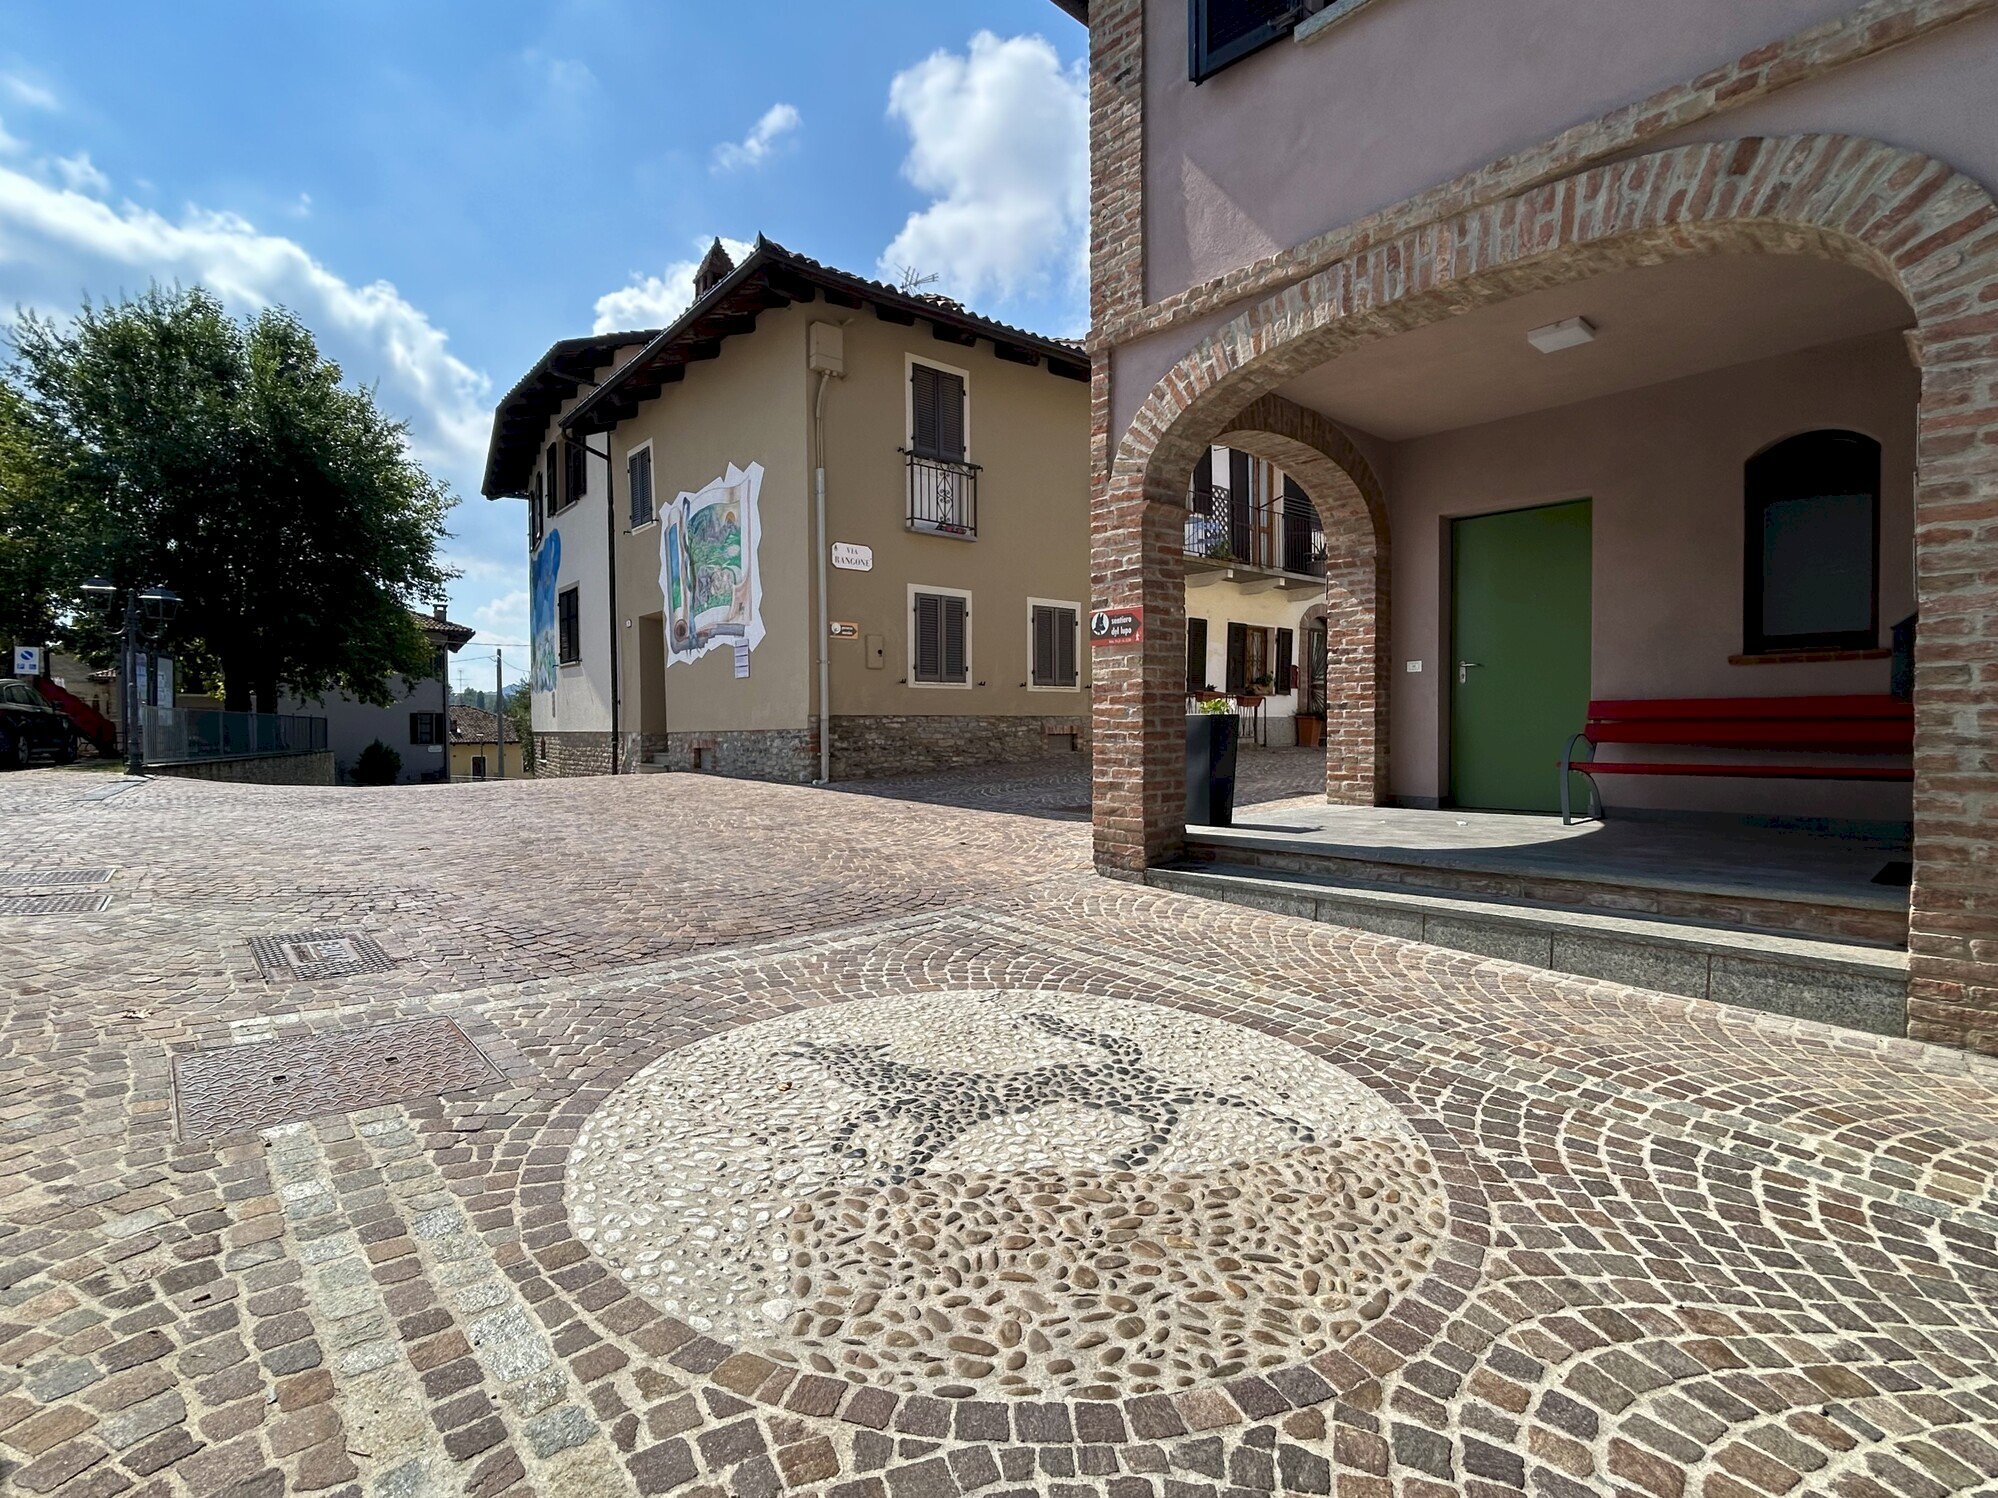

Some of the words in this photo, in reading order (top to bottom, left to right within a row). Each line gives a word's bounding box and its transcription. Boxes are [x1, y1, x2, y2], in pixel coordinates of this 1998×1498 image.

[846, 547, 859, 555] VIA
[1111, 615, 1132, 625] sentiero
[1120, 626, 1132, 637] lupo
